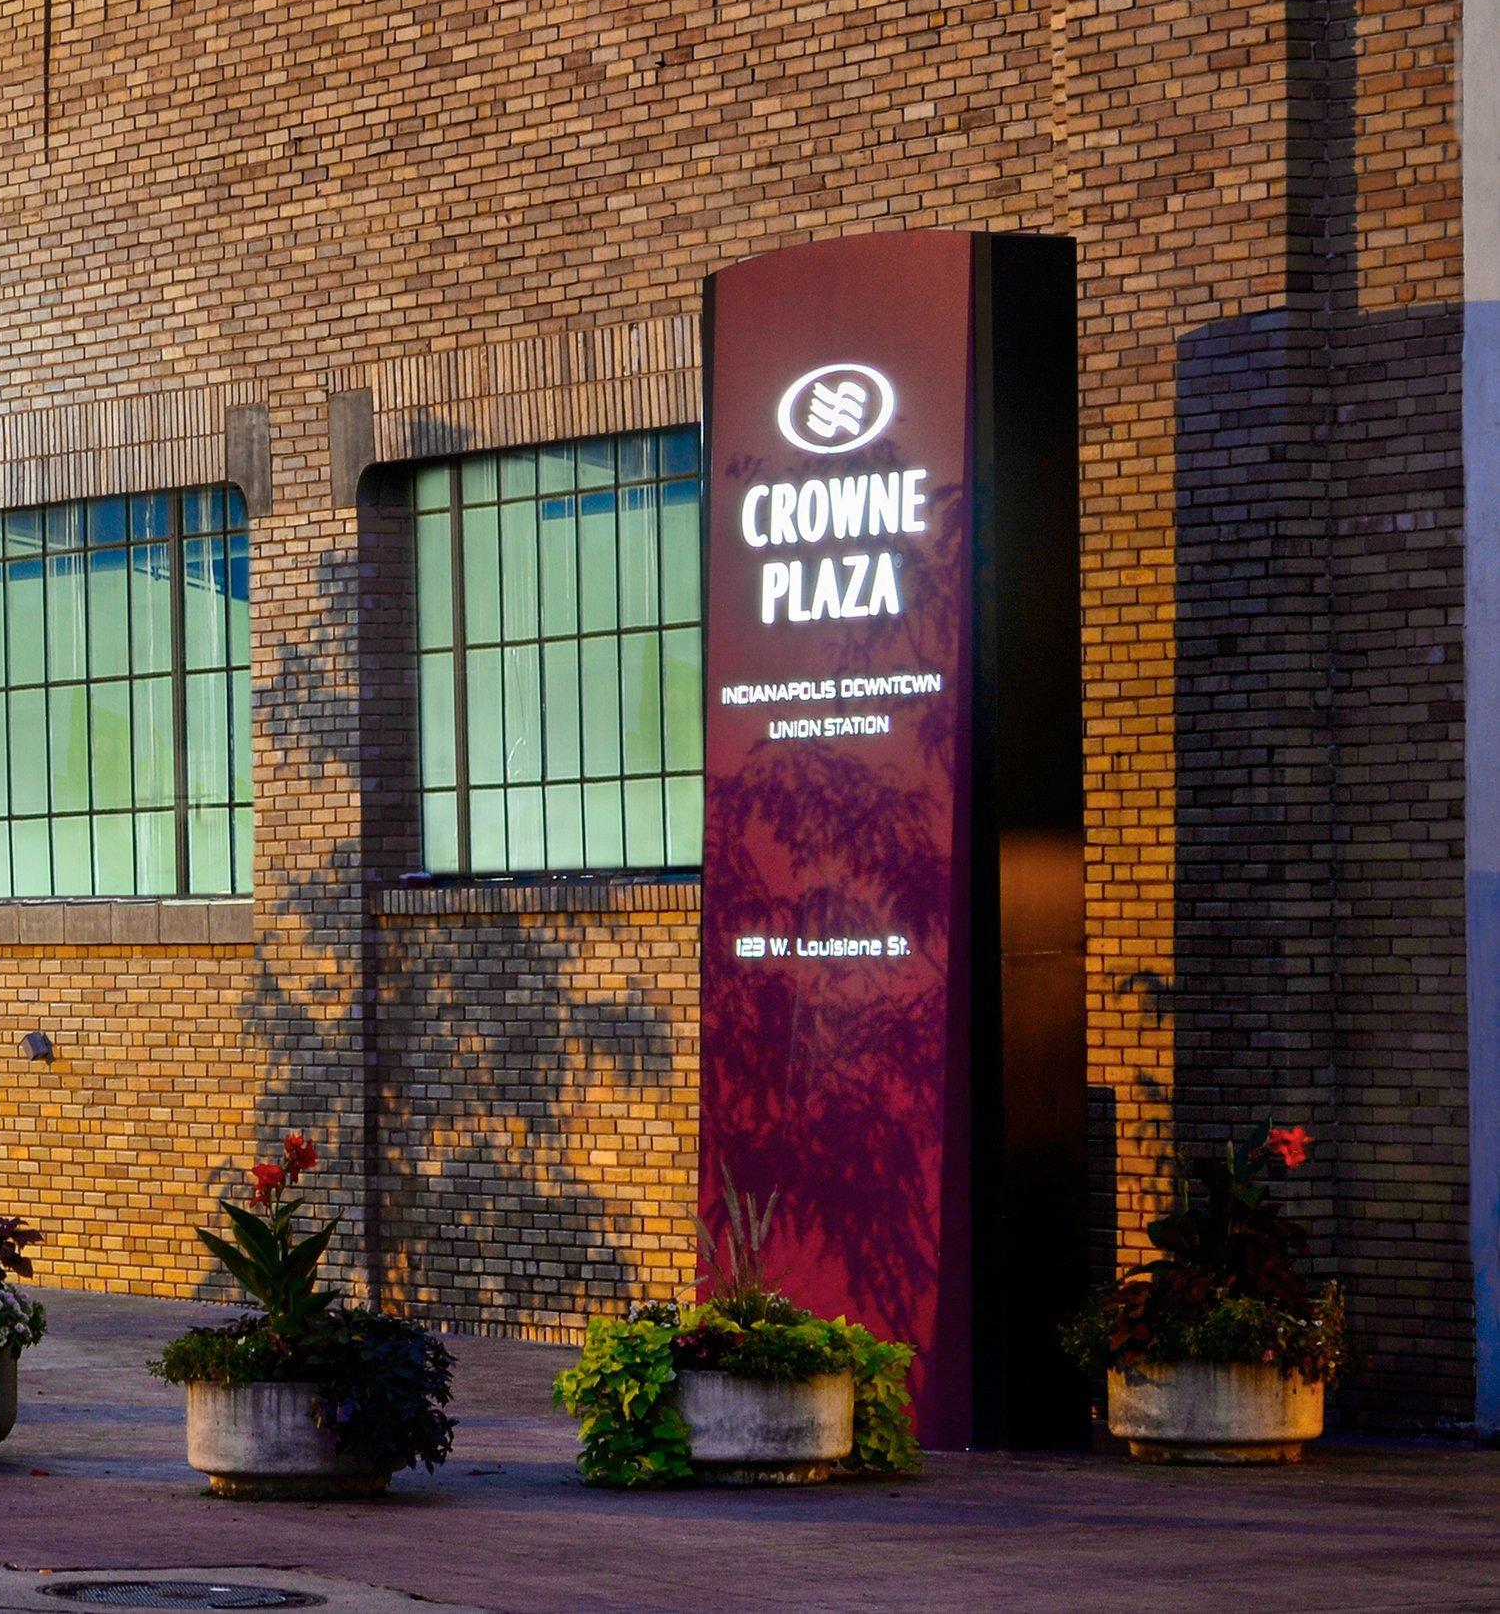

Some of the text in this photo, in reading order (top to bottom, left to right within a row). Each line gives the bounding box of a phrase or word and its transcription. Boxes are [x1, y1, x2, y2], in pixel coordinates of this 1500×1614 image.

[741, 468, 928, 548] CROWNE
[761, 552, 900, 625] PLAZA
[721, 673, 941, 705] INDIANAPOLIS DOWNTOWN
[769, 715, 890, 740] UNION STATION
[735, 936, 911, 957] 123 W. Louisiana St.
